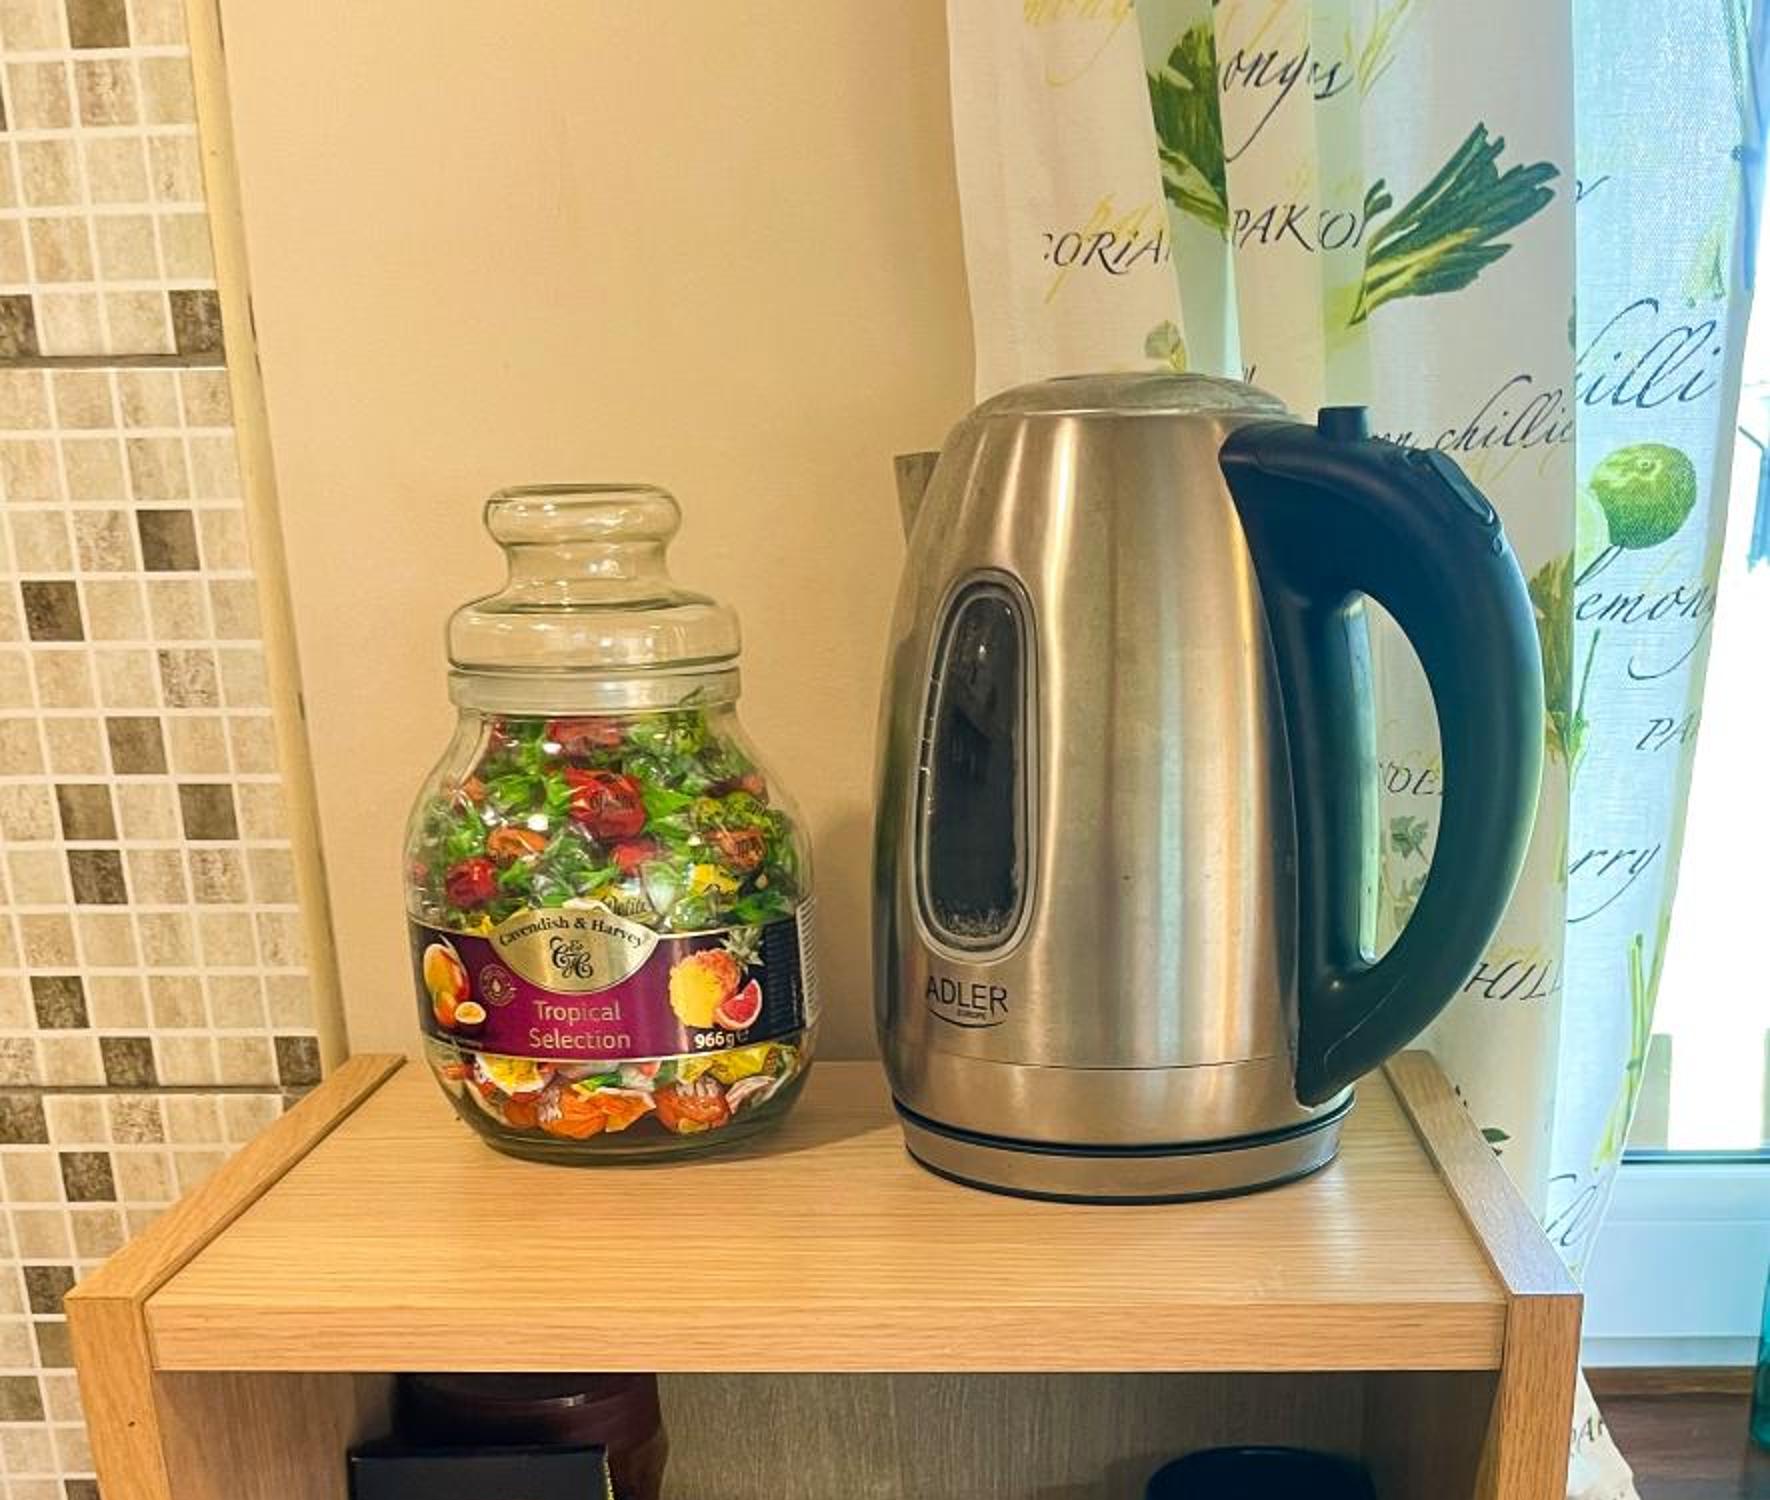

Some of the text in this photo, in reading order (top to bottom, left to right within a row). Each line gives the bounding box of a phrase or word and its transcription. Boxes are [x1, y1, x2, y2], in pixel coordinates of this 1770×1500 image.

[500, 915, 642, 949] Cavendish & Harvey
[926, 975, 1009, 1018] ADLER
[532, 1000, 622, 1027] Tropical
[529, 1027, 631, 1049] Selection
